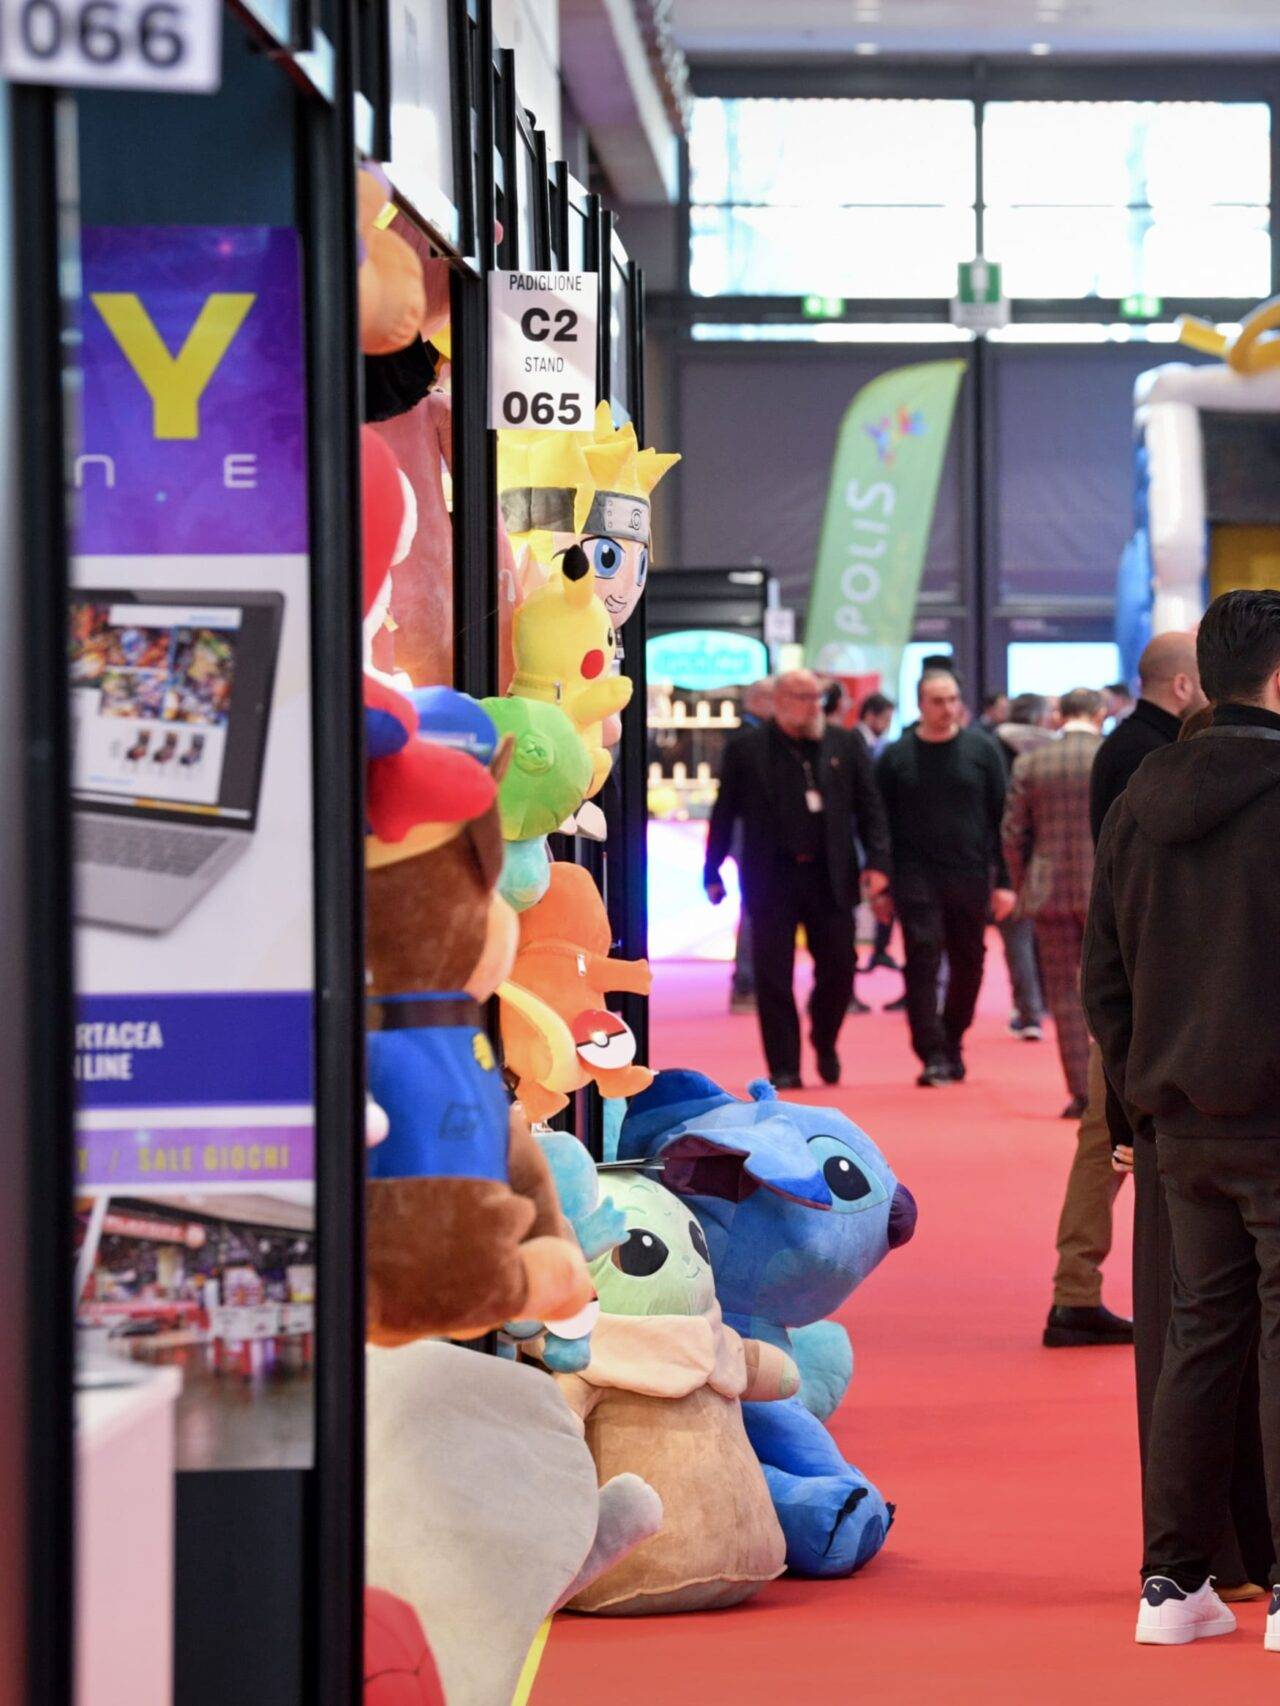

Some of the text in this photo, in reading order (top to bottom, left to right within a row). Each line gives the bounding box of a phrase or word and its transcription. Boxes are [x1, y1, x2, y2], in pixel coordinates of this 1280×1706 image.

[21, 0, 186, 69] 066
[509, 274, 582, 291] PADIGLIONE
[520, 307, 578, 342] C2
[90, 292, 257, 440] Y
[524, 356, 564, 373] STAND
[502, 391, 581, 425] 065
[138, 1146, 193, 1172] SALE
[204, 1144, 289, 1171] GIOCHI
